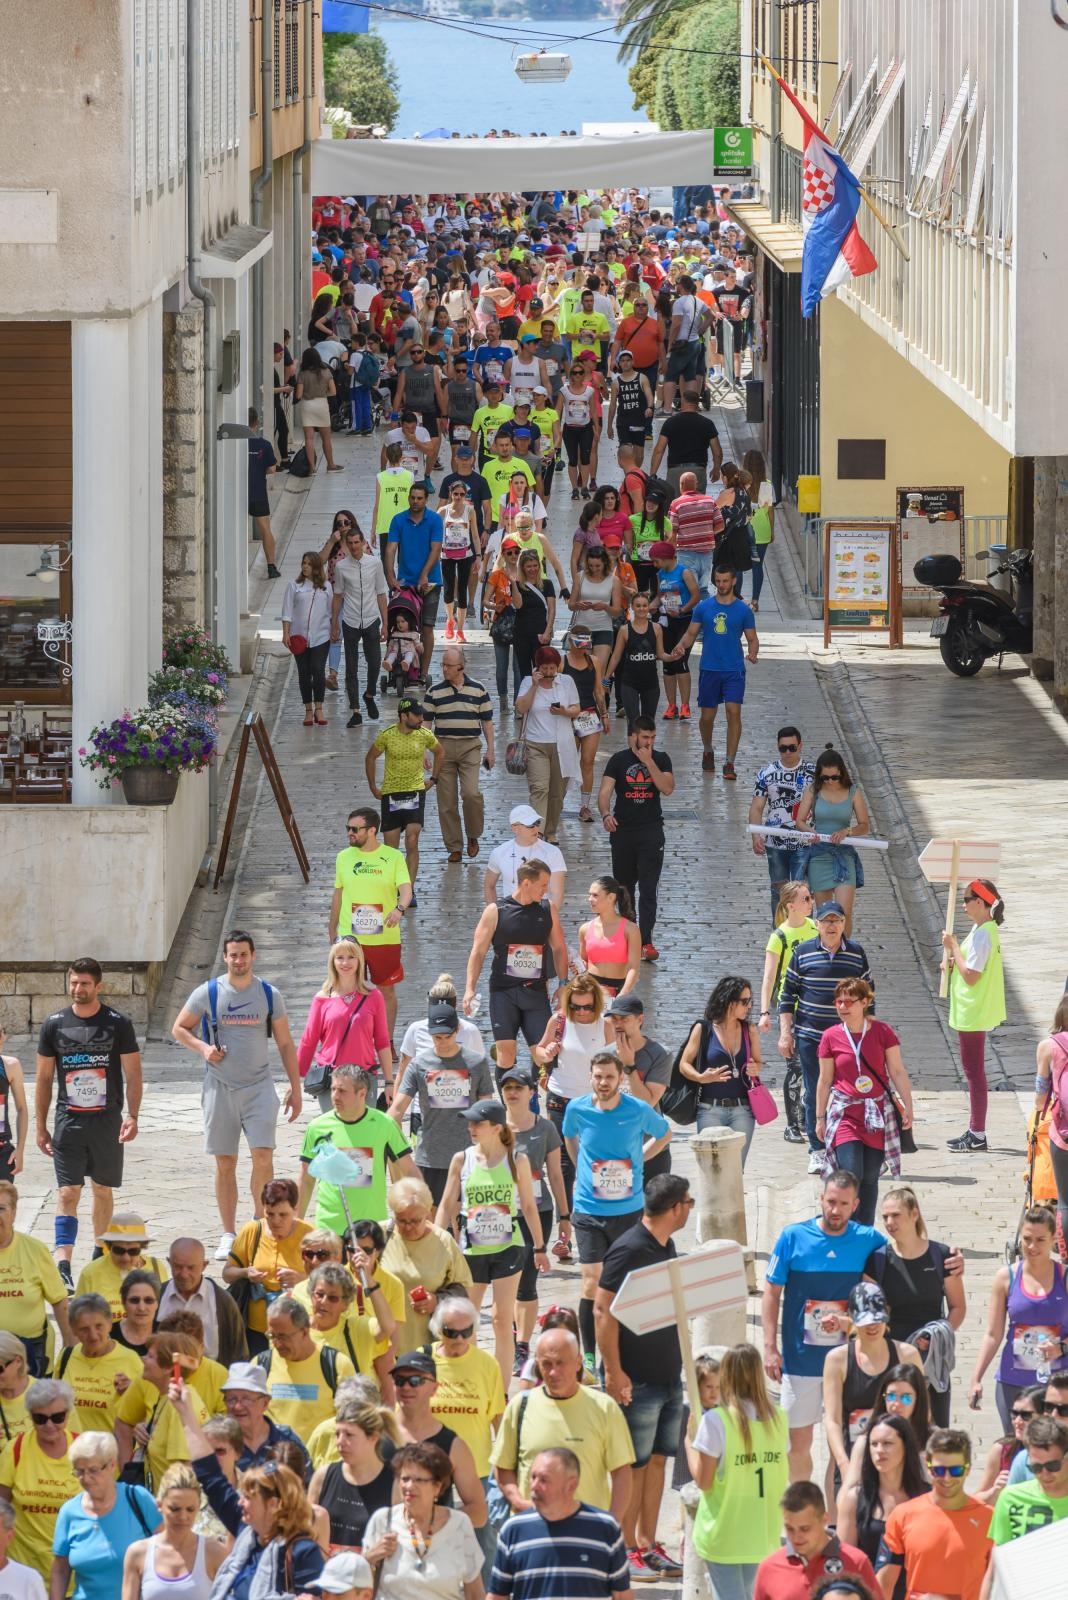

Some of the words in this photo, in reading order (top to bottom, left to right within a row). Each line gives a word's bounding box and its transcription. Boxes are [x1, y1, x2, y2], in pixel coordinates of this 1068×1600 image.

[513, 960, 537, 969] 90320
[221, 1013, 259, 1025] FOOTBALL
[76, 1087, 98, 1097] 7495
[435, 1088, 462, 1097] 32009
[467, 1190, 512, 1205] FORCA
[475, 1223, 505, 1234] 27140
[38, 1478, 66, 1487] MATICA
[755, 1467, 764, 1498] 1
